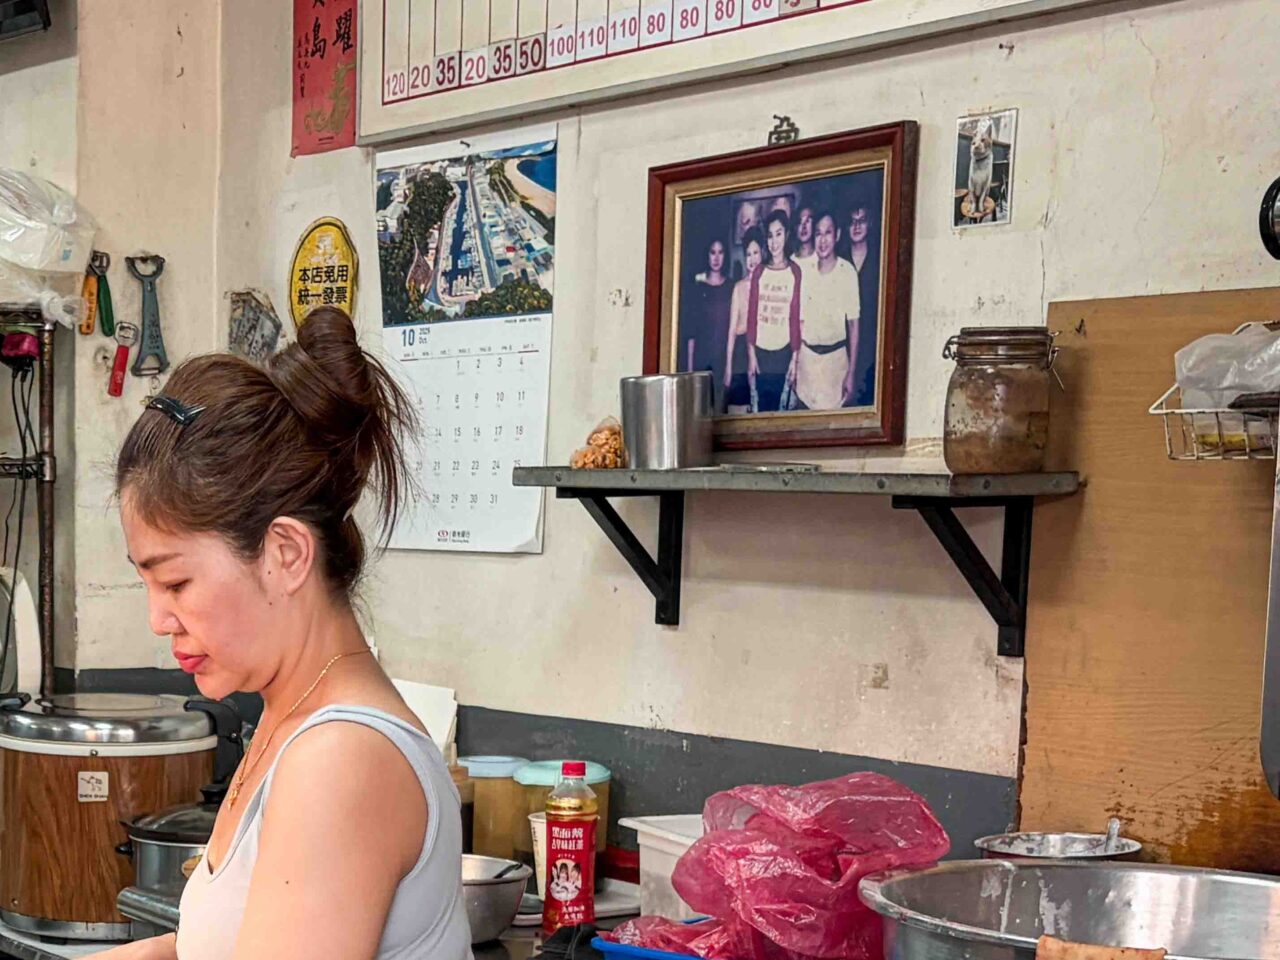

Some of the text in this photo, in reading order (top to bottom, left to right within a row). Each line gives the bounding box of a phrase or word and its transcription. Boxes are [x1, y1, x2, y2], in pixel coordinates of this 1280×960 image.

[386, 72, 405, 97] 120
[410, 64, 431, 90] 20
[436, 56, 456, 86] 35
[465, 55, 486, 81] 20
[493, 44, 512, 75] 35
[519, 37, 542, 70] 50
[549, 34, 574, 57] 100
[579, 26, 605, 49] 110
[610, 16, 637, 40] 110
[646, 12, 665, 35] 80
[680, 6, 699, 30] 80
[714, 0, 735, 21] 80
[298, 264, 349, 284] 本店免用
[296, 285, 348, 305] 統一發票
[402, 329, 415, 346] 10
[496, 392, 504, 402] 10
